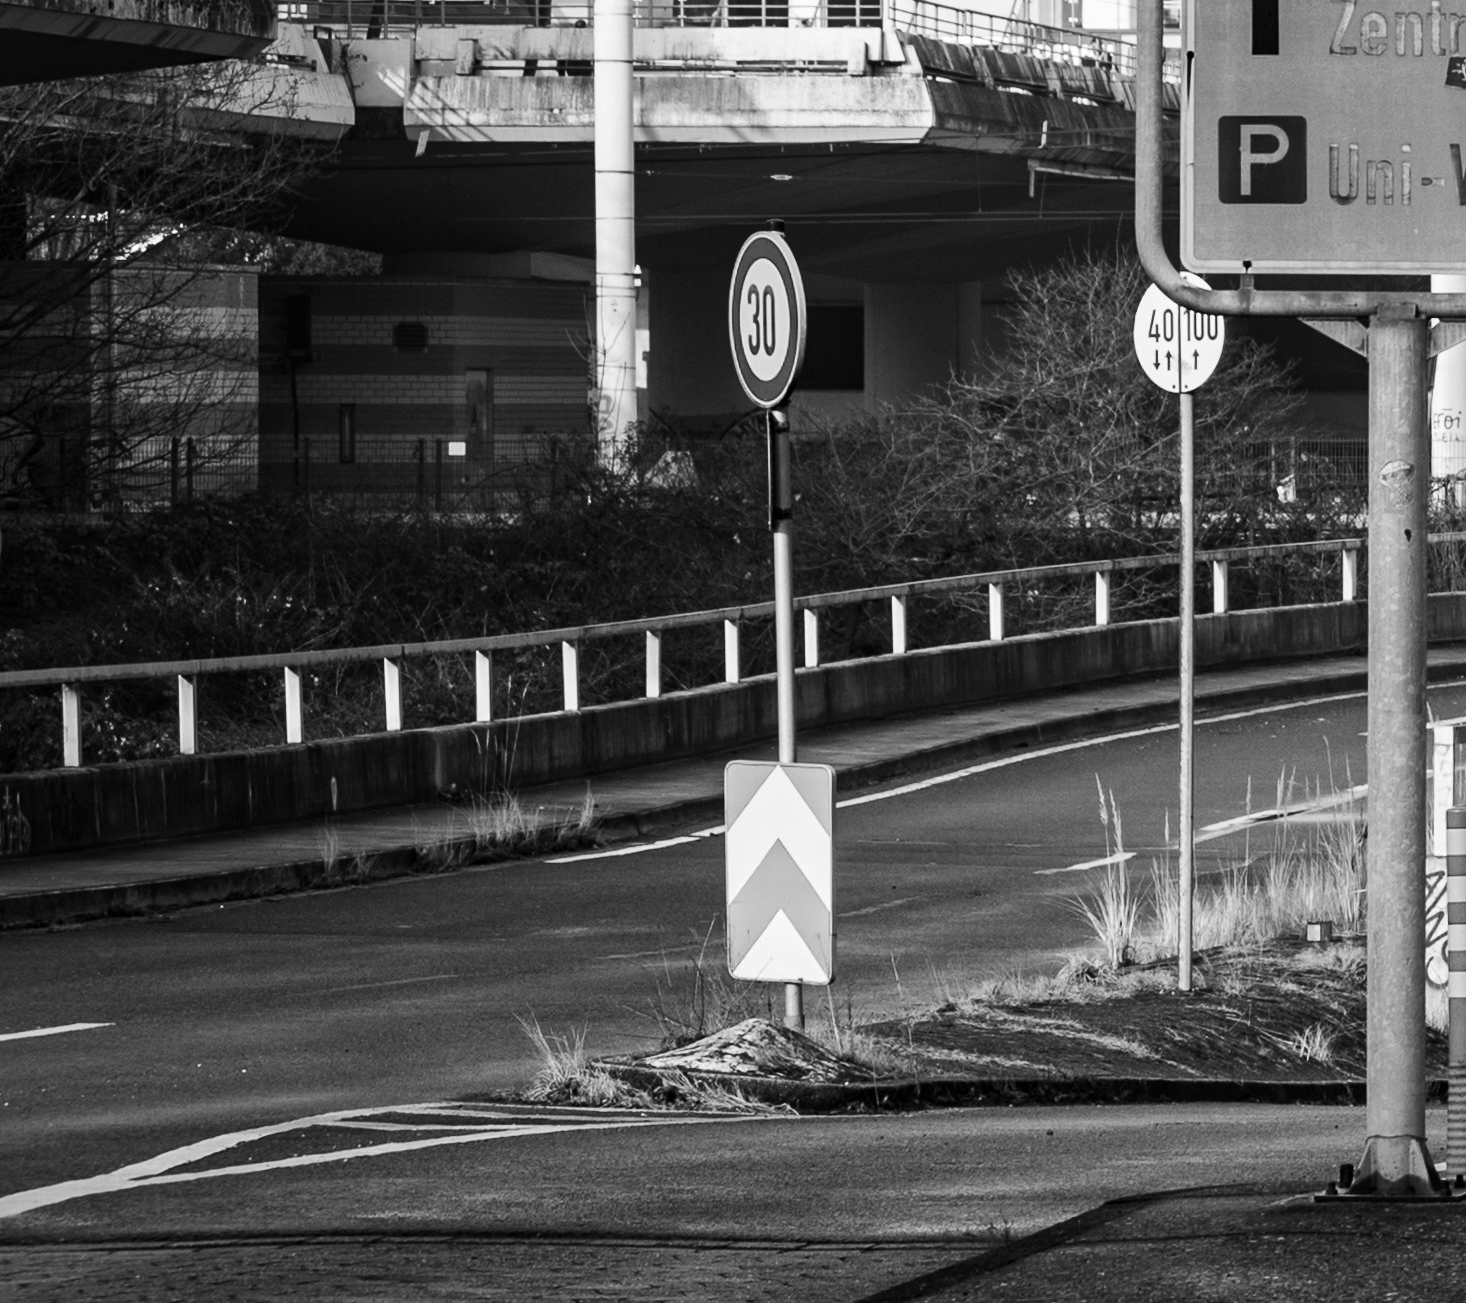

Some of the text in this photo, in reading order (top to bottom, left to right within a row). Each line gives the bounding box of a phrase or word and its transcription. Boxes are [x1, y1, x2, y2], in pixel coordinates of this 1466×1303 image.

[746, 283, 777, 357] 30
[1148, 308, 1218, 343] 40 100
